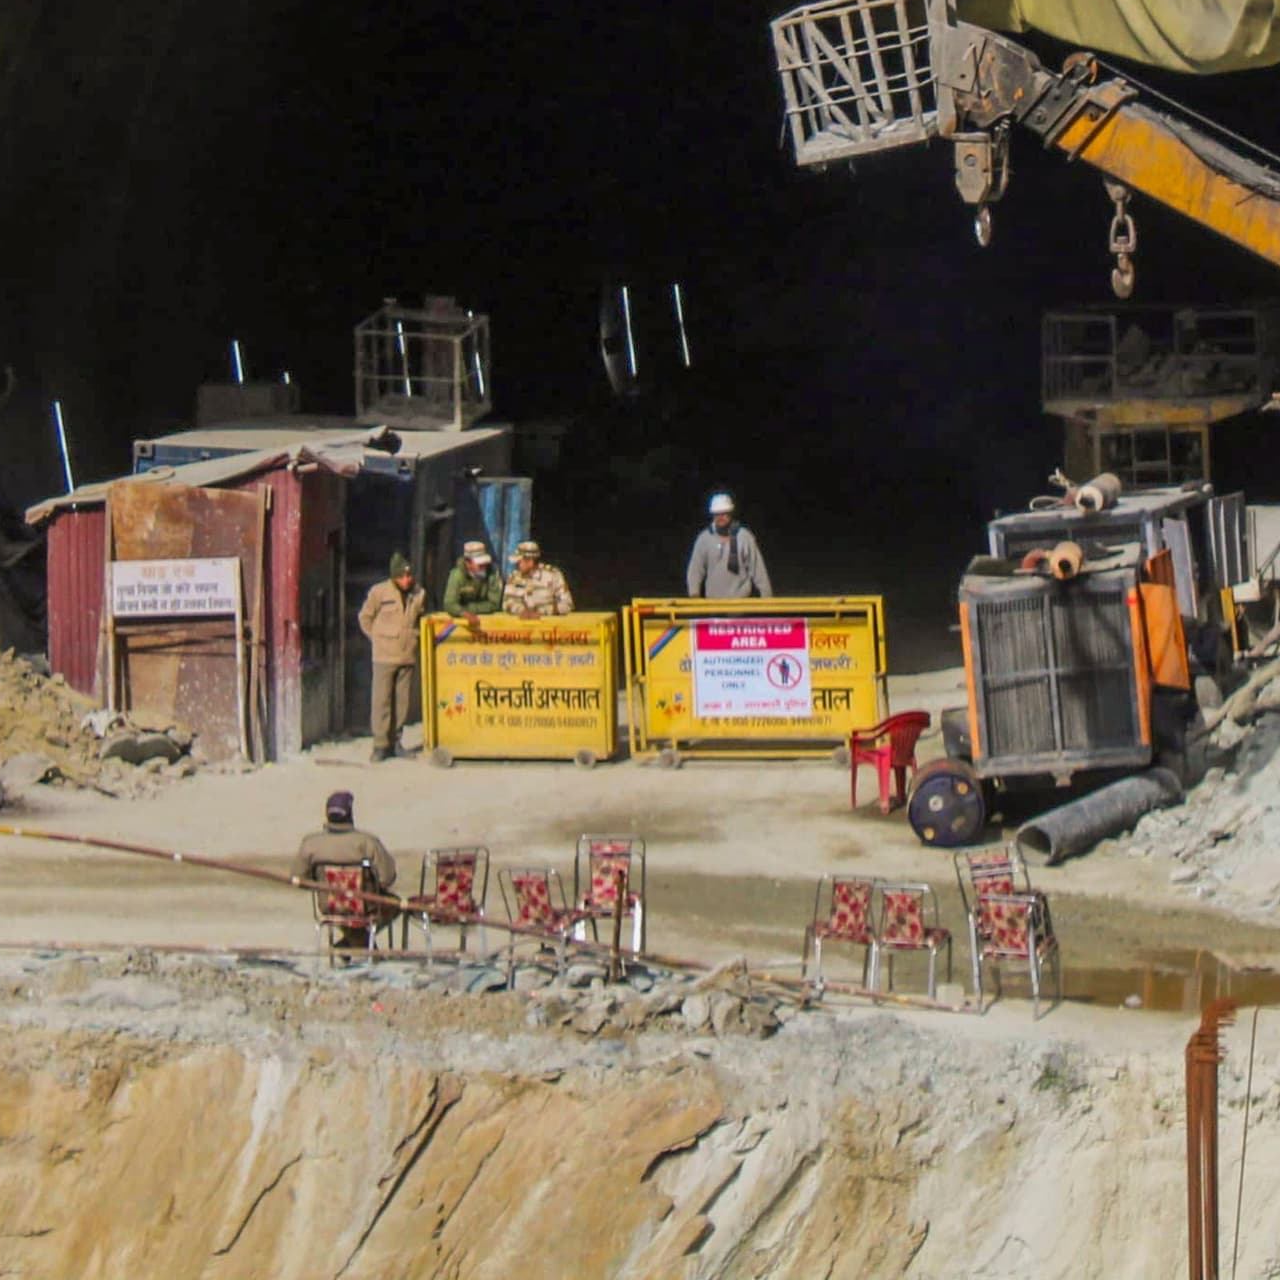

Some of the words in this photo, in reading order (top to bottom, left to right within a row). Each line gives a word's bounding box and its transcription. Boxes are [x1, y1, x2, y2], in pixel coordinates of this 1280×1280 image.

[708, 623, 792, 636] RESTRICTED
[731, 636, 767, 649] AREA
[475, 679, 534, 709] सिनर्जी
[535, 686, 601, 711] अस्पताल
